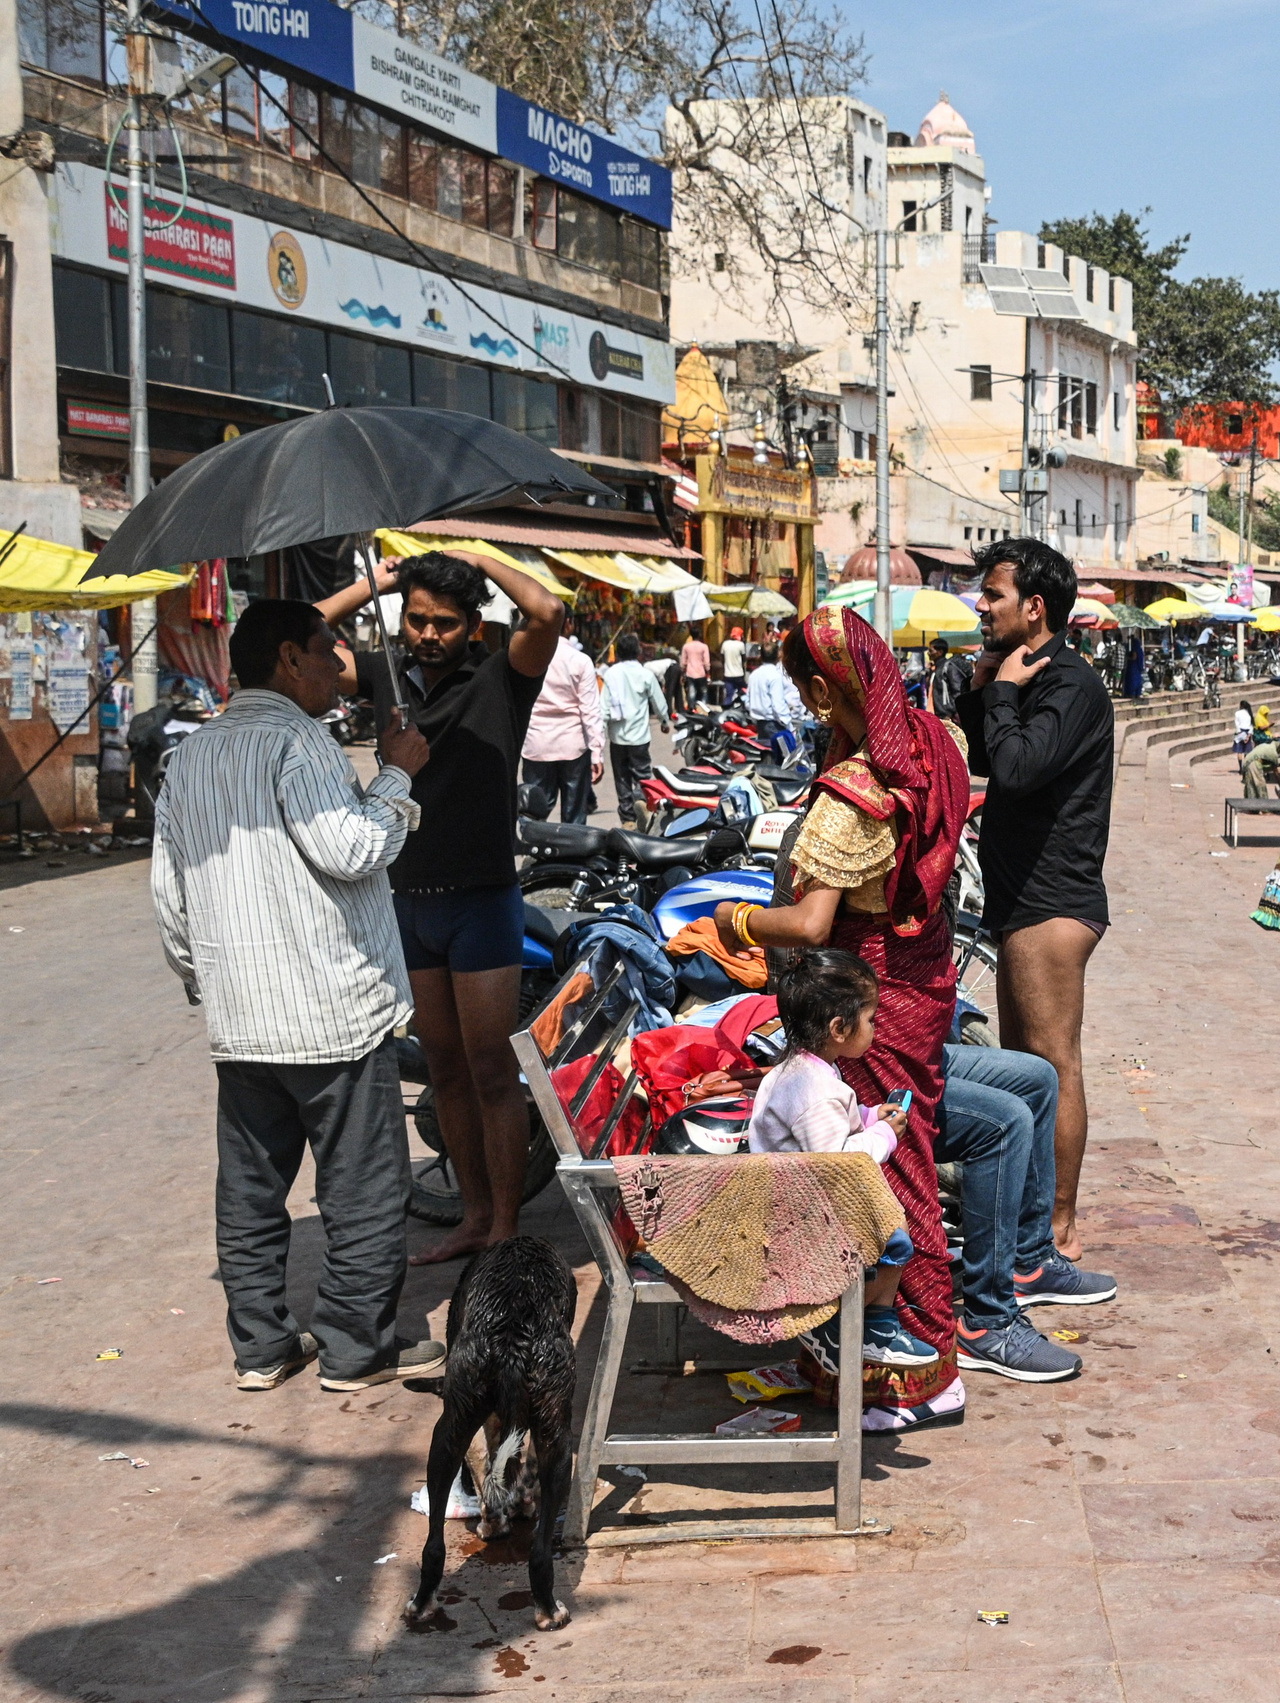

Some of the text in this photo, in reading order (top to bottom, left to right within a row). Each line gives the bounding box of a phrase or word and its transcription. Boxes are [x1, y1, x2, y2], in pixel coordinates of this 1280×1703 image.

[232, 1, 310, 38] TOING HAI
[371, 55, 481, 118] BISHRAM GRIHA RAMGHAT
[395, 47, 461, 91] GANGALE YARTI
[401, 89, 456, 125] CHITRAKOOT
[528, 107, 593, 164] MACHO
[560, 159, 593, 189] SPORTO
[607, 174, 651, 197] TOING HAI
[143, 216, 200, 251] BANARASI
[202, 232, 233, 261] PAAN
